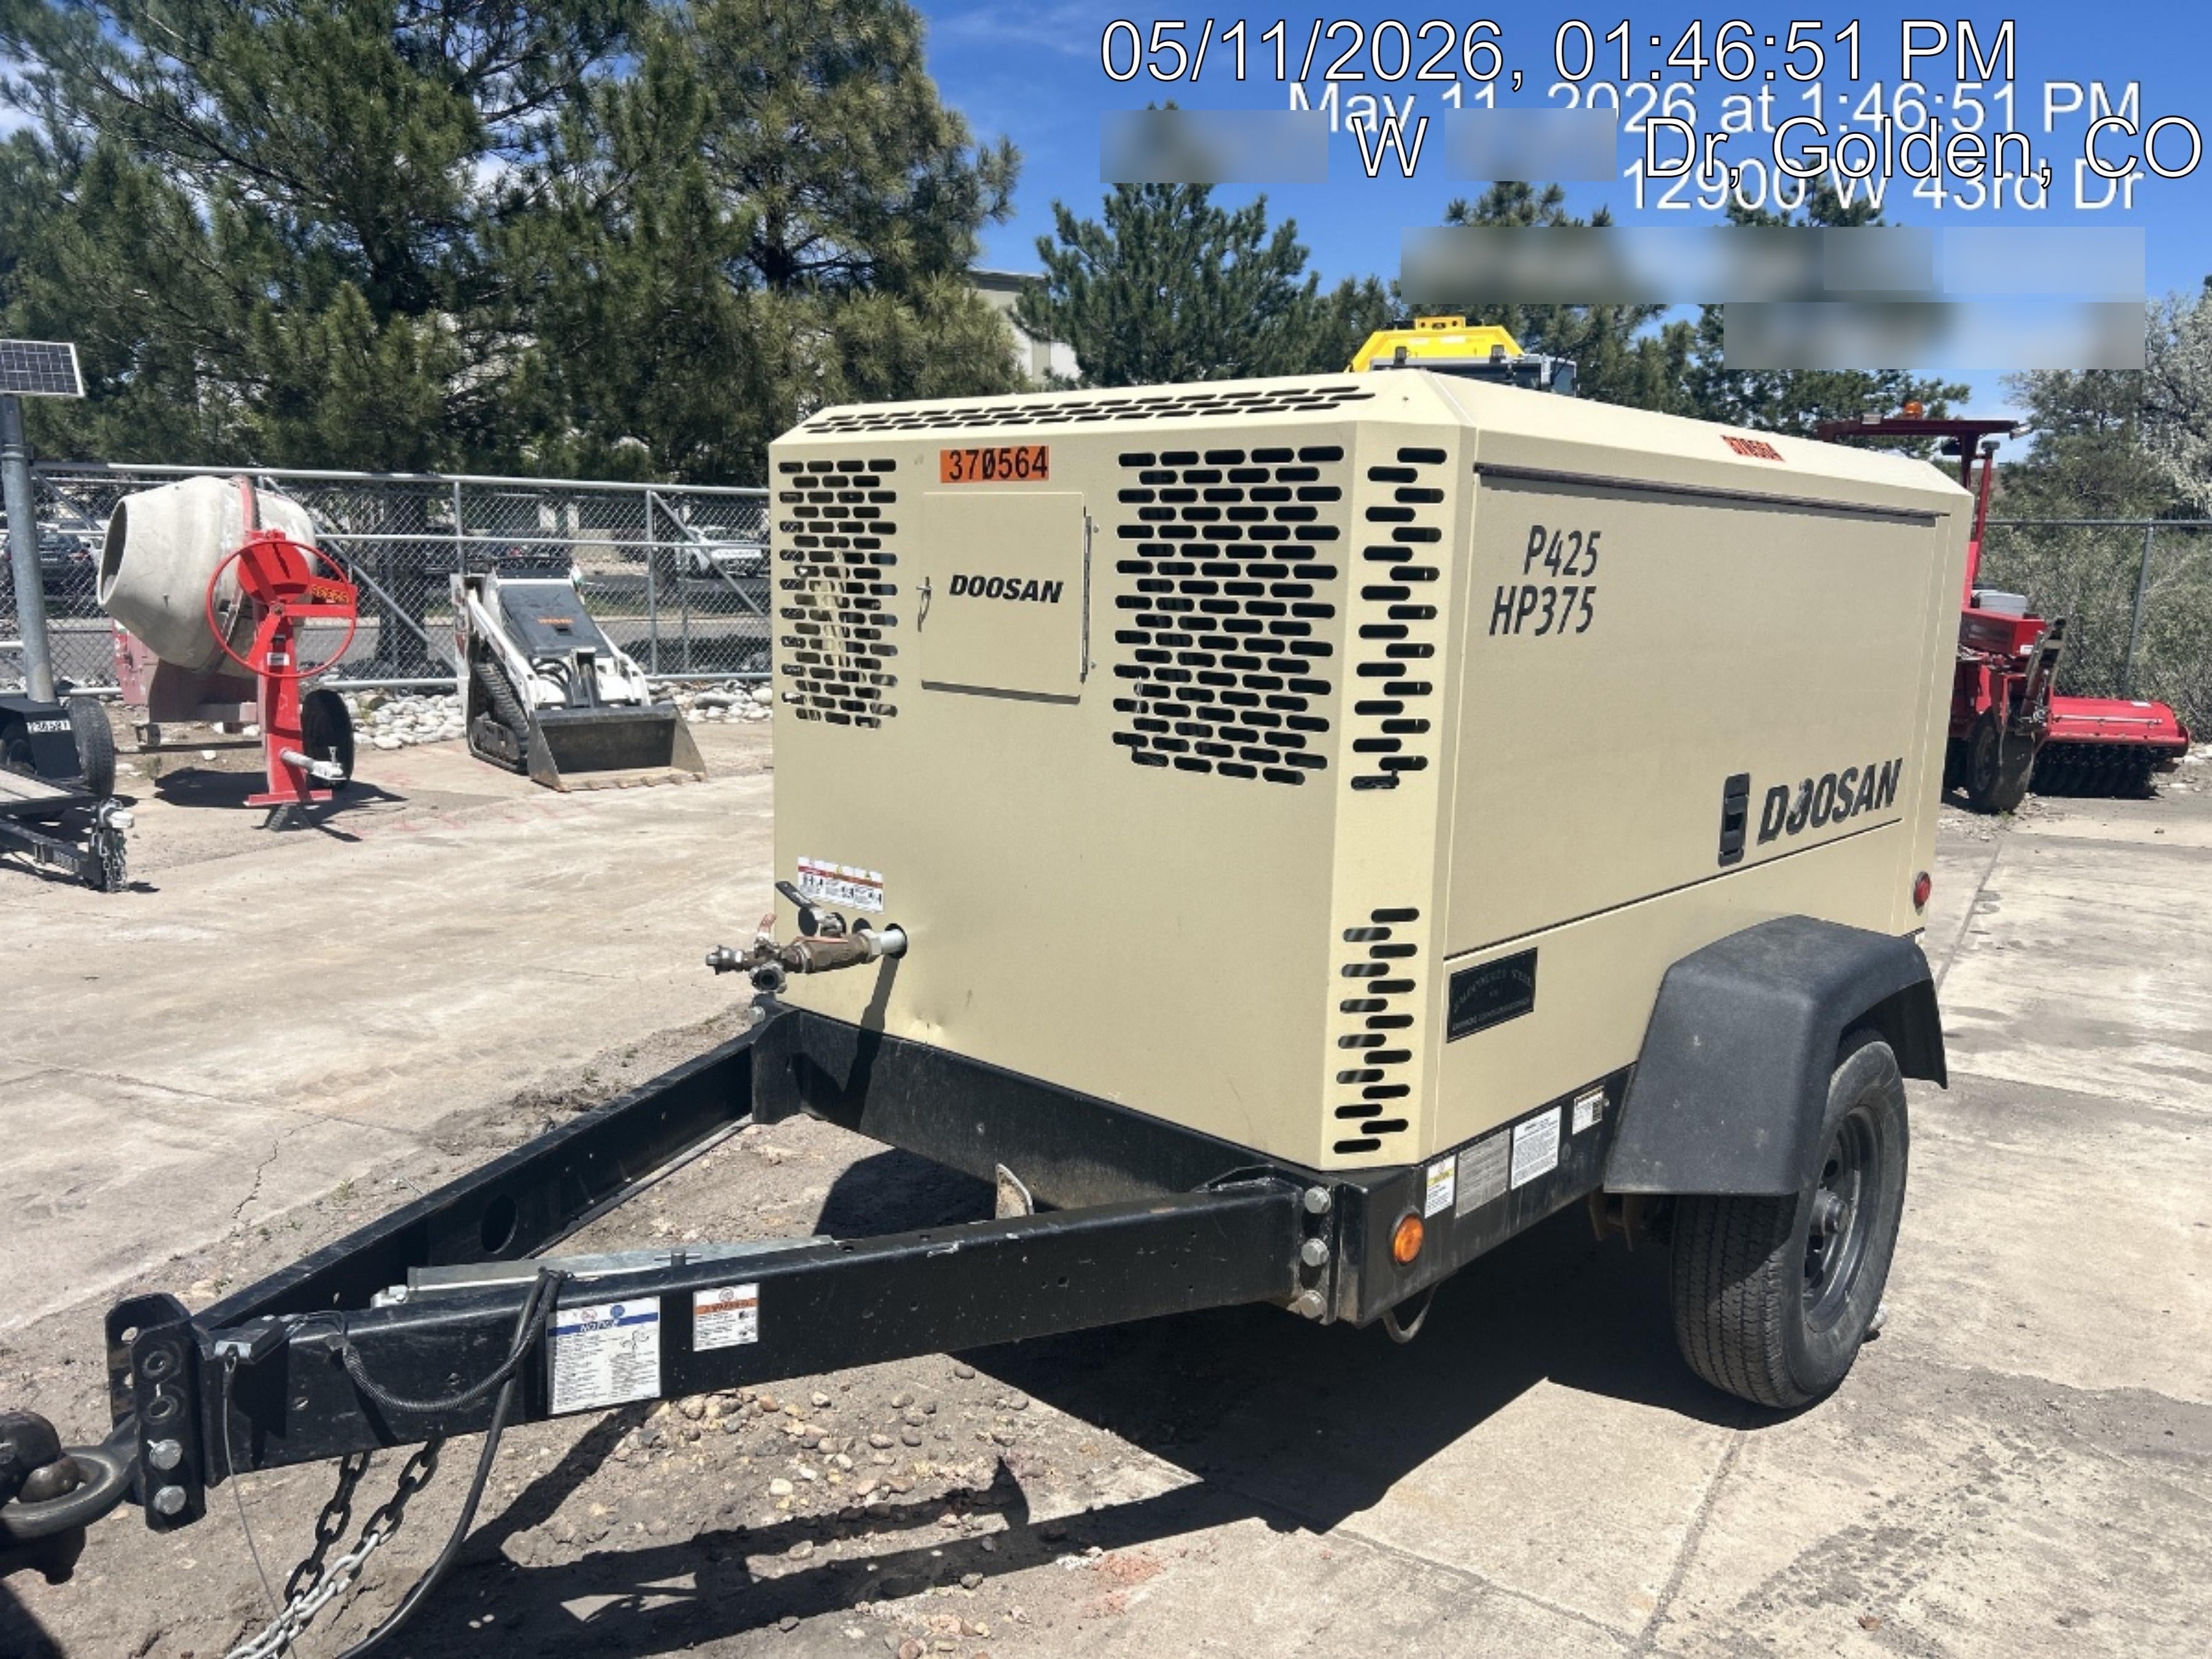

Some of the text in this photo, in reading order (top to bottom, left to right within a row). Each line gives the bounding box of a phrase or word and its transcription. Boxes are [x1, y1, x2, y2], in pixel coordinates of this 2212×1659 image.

[949, 446, 1048, 480] 370564
[1523, 525, 1602, 578] P425
[949, 575, 1064, 603] DOOSAN
[1489, 586, 1597, 636] HP375
